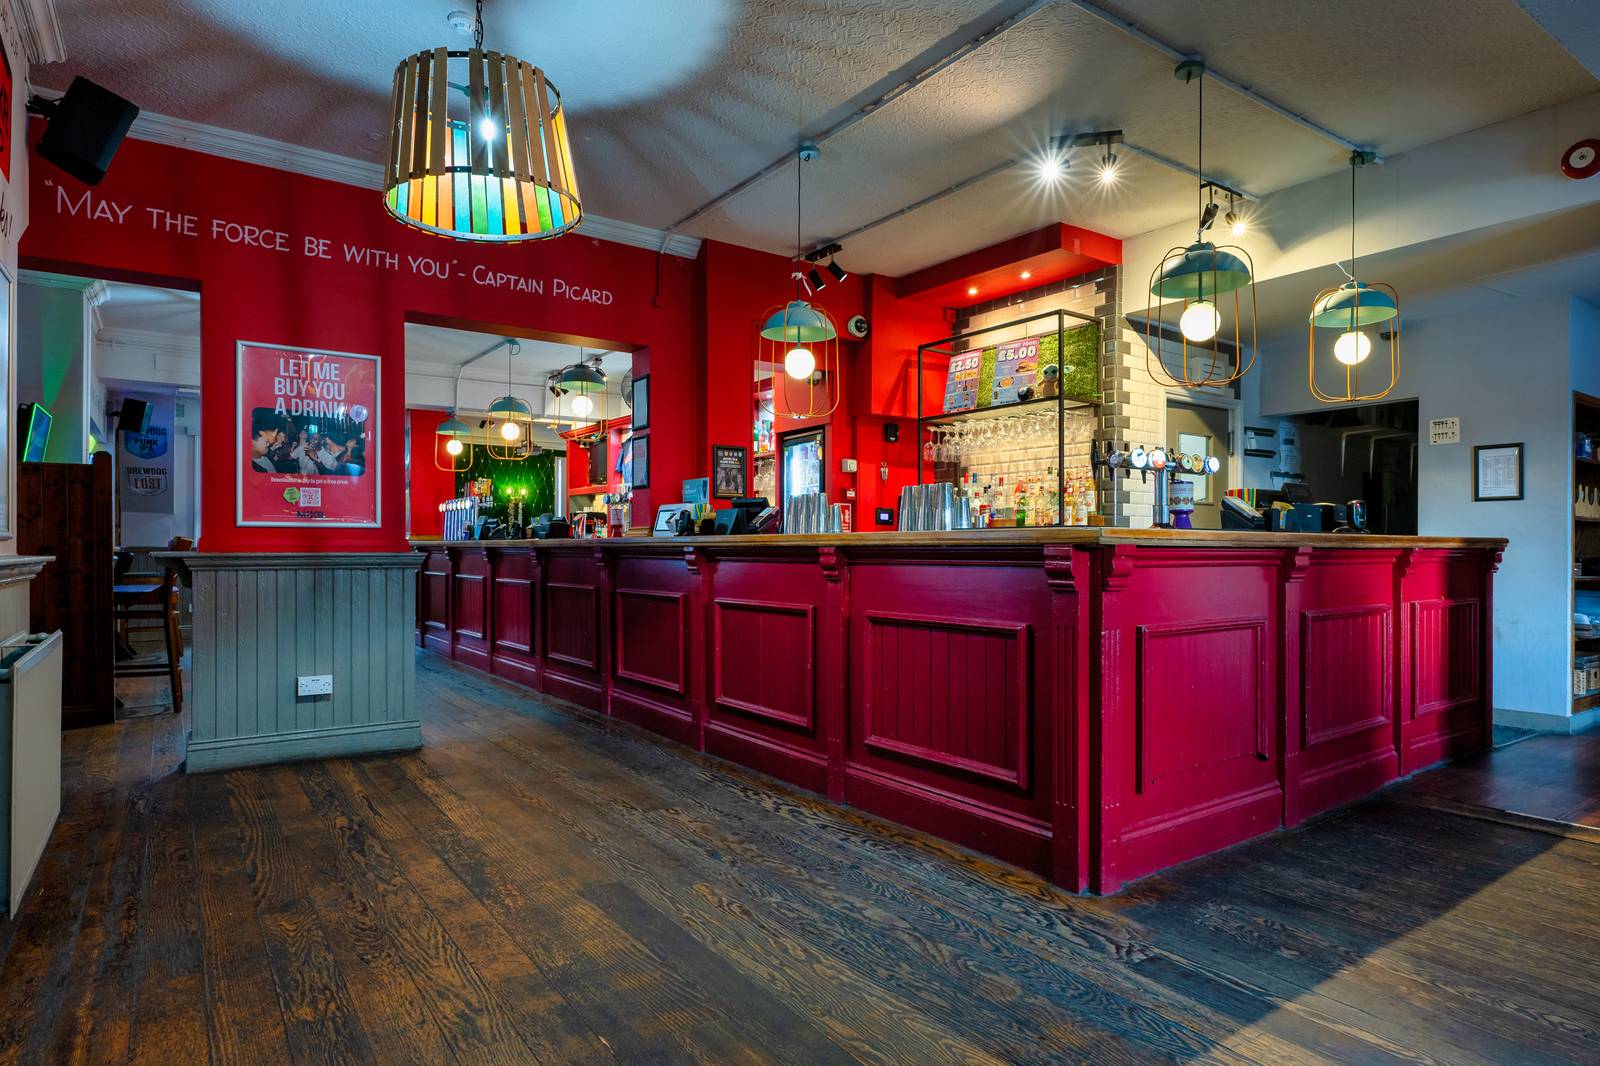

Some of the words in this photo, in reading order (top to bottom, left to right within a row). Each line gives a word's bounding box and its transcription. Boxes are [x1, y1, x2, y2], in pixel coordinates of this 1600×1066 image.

[146, 208, 199, 237] THE
[212, 218, 290, 253] FORCE
[304, 235, 332, 259] BE
[343, 244, 399, 272] WITH
[472, 265, 544, 297] CAPTAIN
[551, 278, 613, 306] PICARD
[998, 346, 1037, 362] £5.00
[279, 358, 308, 377] LET
[314, 362, 340, 380] ME
[275, 377, 308, 396] BUY
[313, 381, 345, 399] YOU
[274, 397, 287, 415] A
[292, 399, 345, 419] DRINK
[135, 438, 159, 446] PUNK
[127, 467, 167, 476] BREWDOG
[136, 478, 161, 489] LOST
